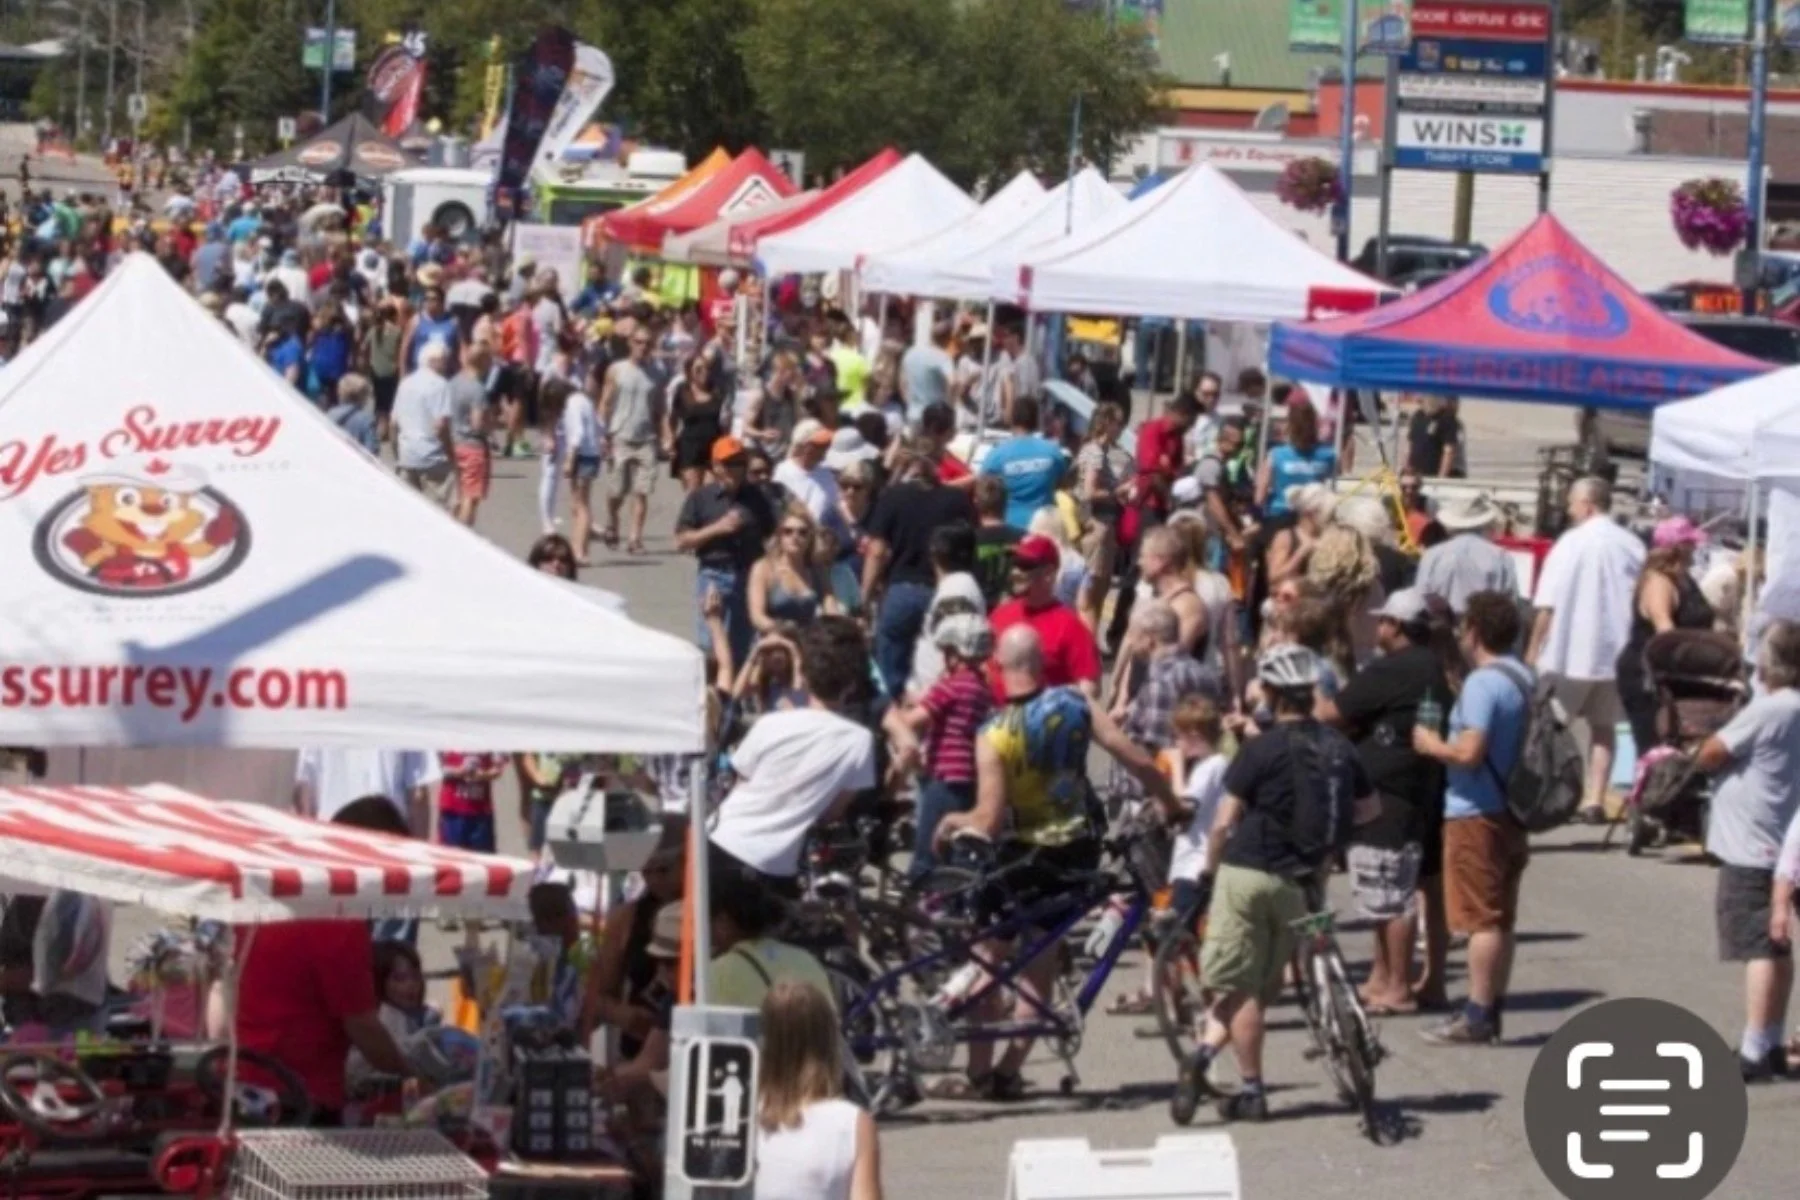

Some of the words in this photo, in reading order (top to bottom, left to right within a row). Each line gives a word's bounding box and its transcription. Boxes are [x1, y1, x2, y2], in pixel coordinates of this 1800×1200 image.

[1413, 120, 1497, 146] WINS
[1424, 151, 1469, 164] THRIFT
[1471, 154, 1512, 166] STORE
[0, 434, 87, 500] Yes
[99, 404, 281, 458] Surrey
[1, 663, 347, 723] ssurrey.com
